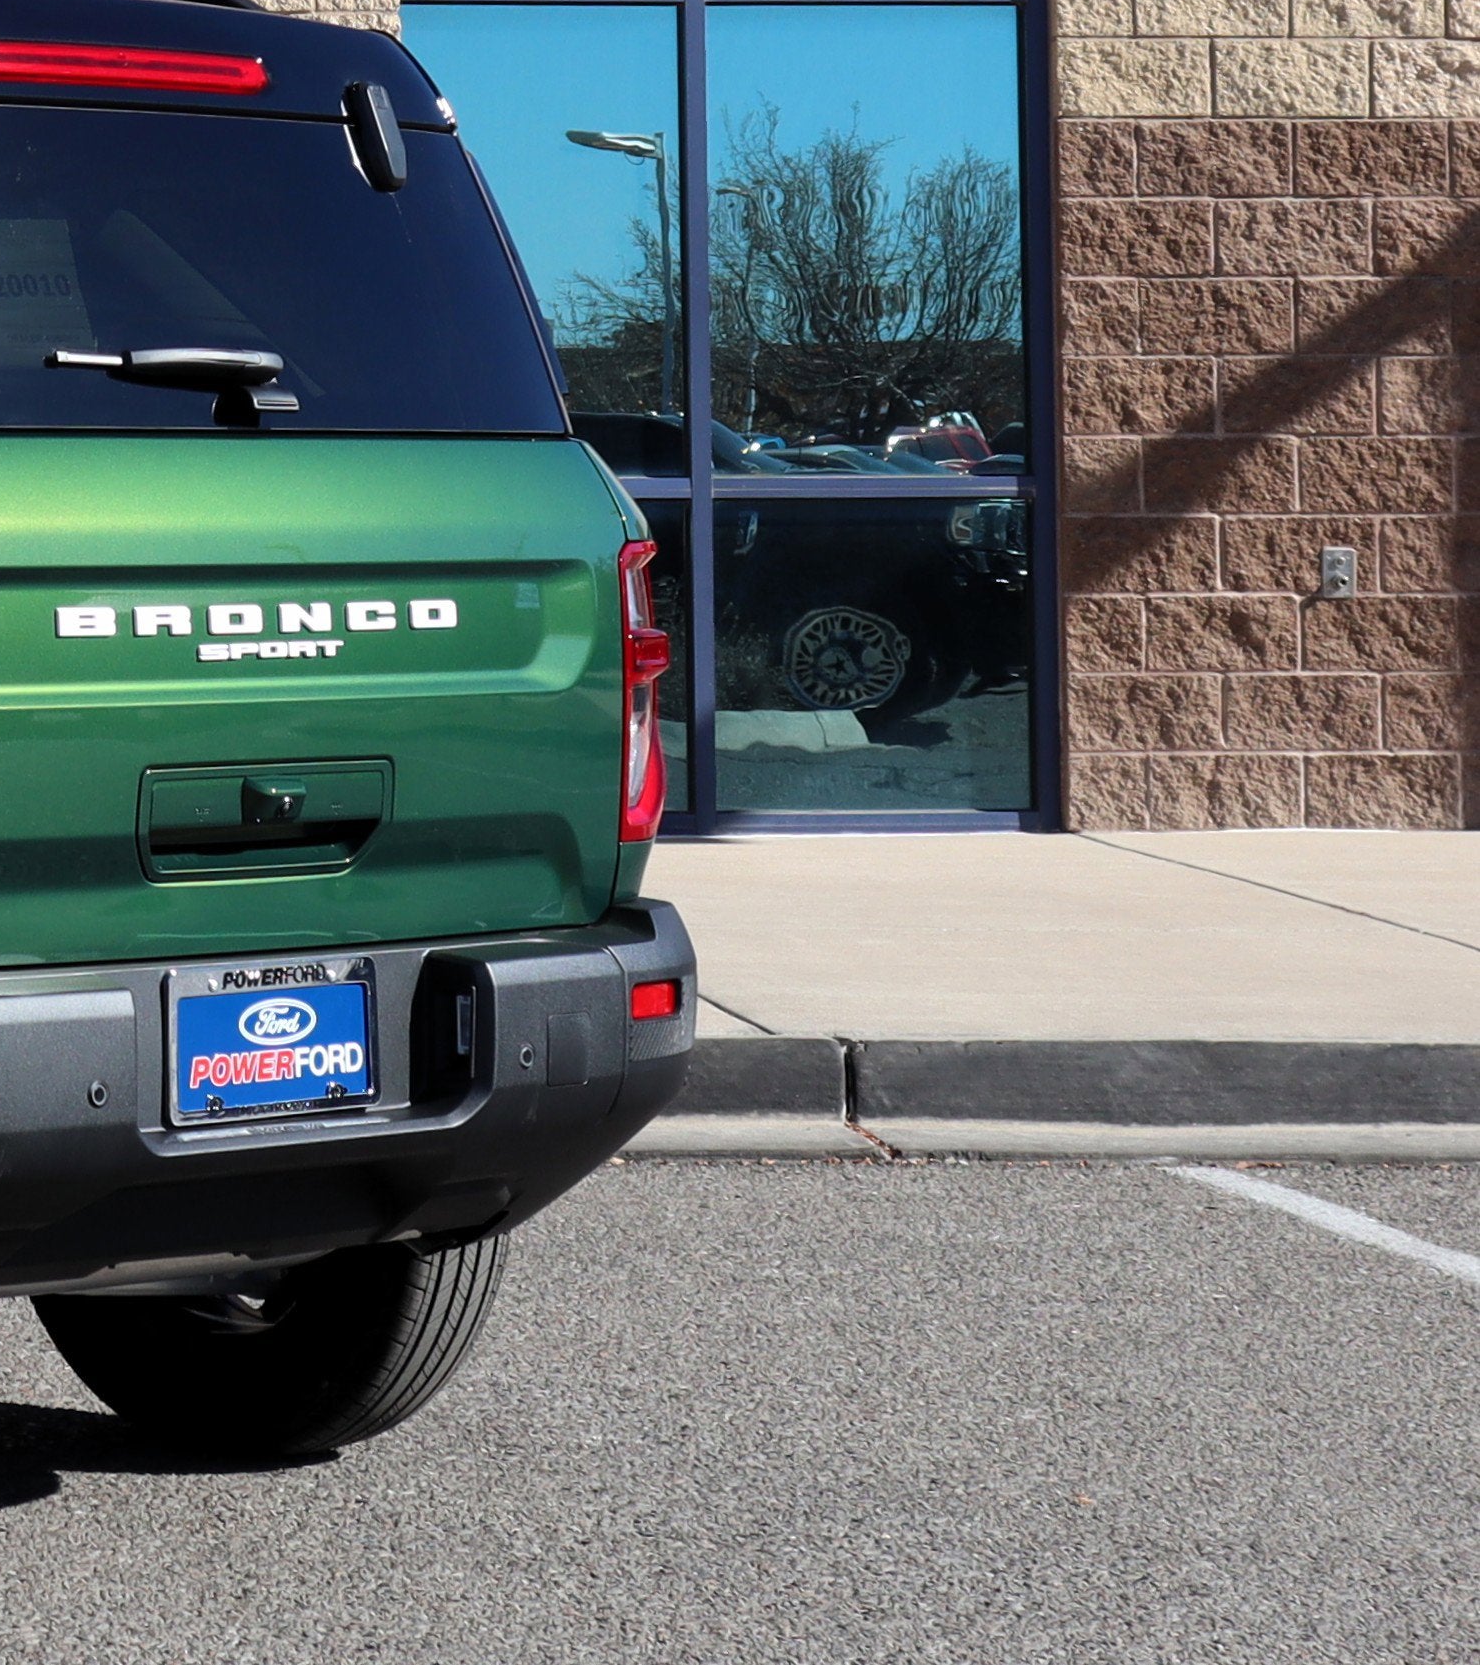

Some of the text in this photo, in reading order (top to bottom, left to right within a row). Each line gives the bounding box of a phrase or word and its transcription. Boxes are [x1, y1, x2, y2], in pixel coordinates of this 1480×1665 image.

[55, 598, 459, 637] BRONCO
[197, 640, 345, 662] SPORT
[221, 963, 327, 990] POWERFORD
[254, 1006, 301, 1036] Ford
[190, 1041, 364, 1089] POWERFORD
